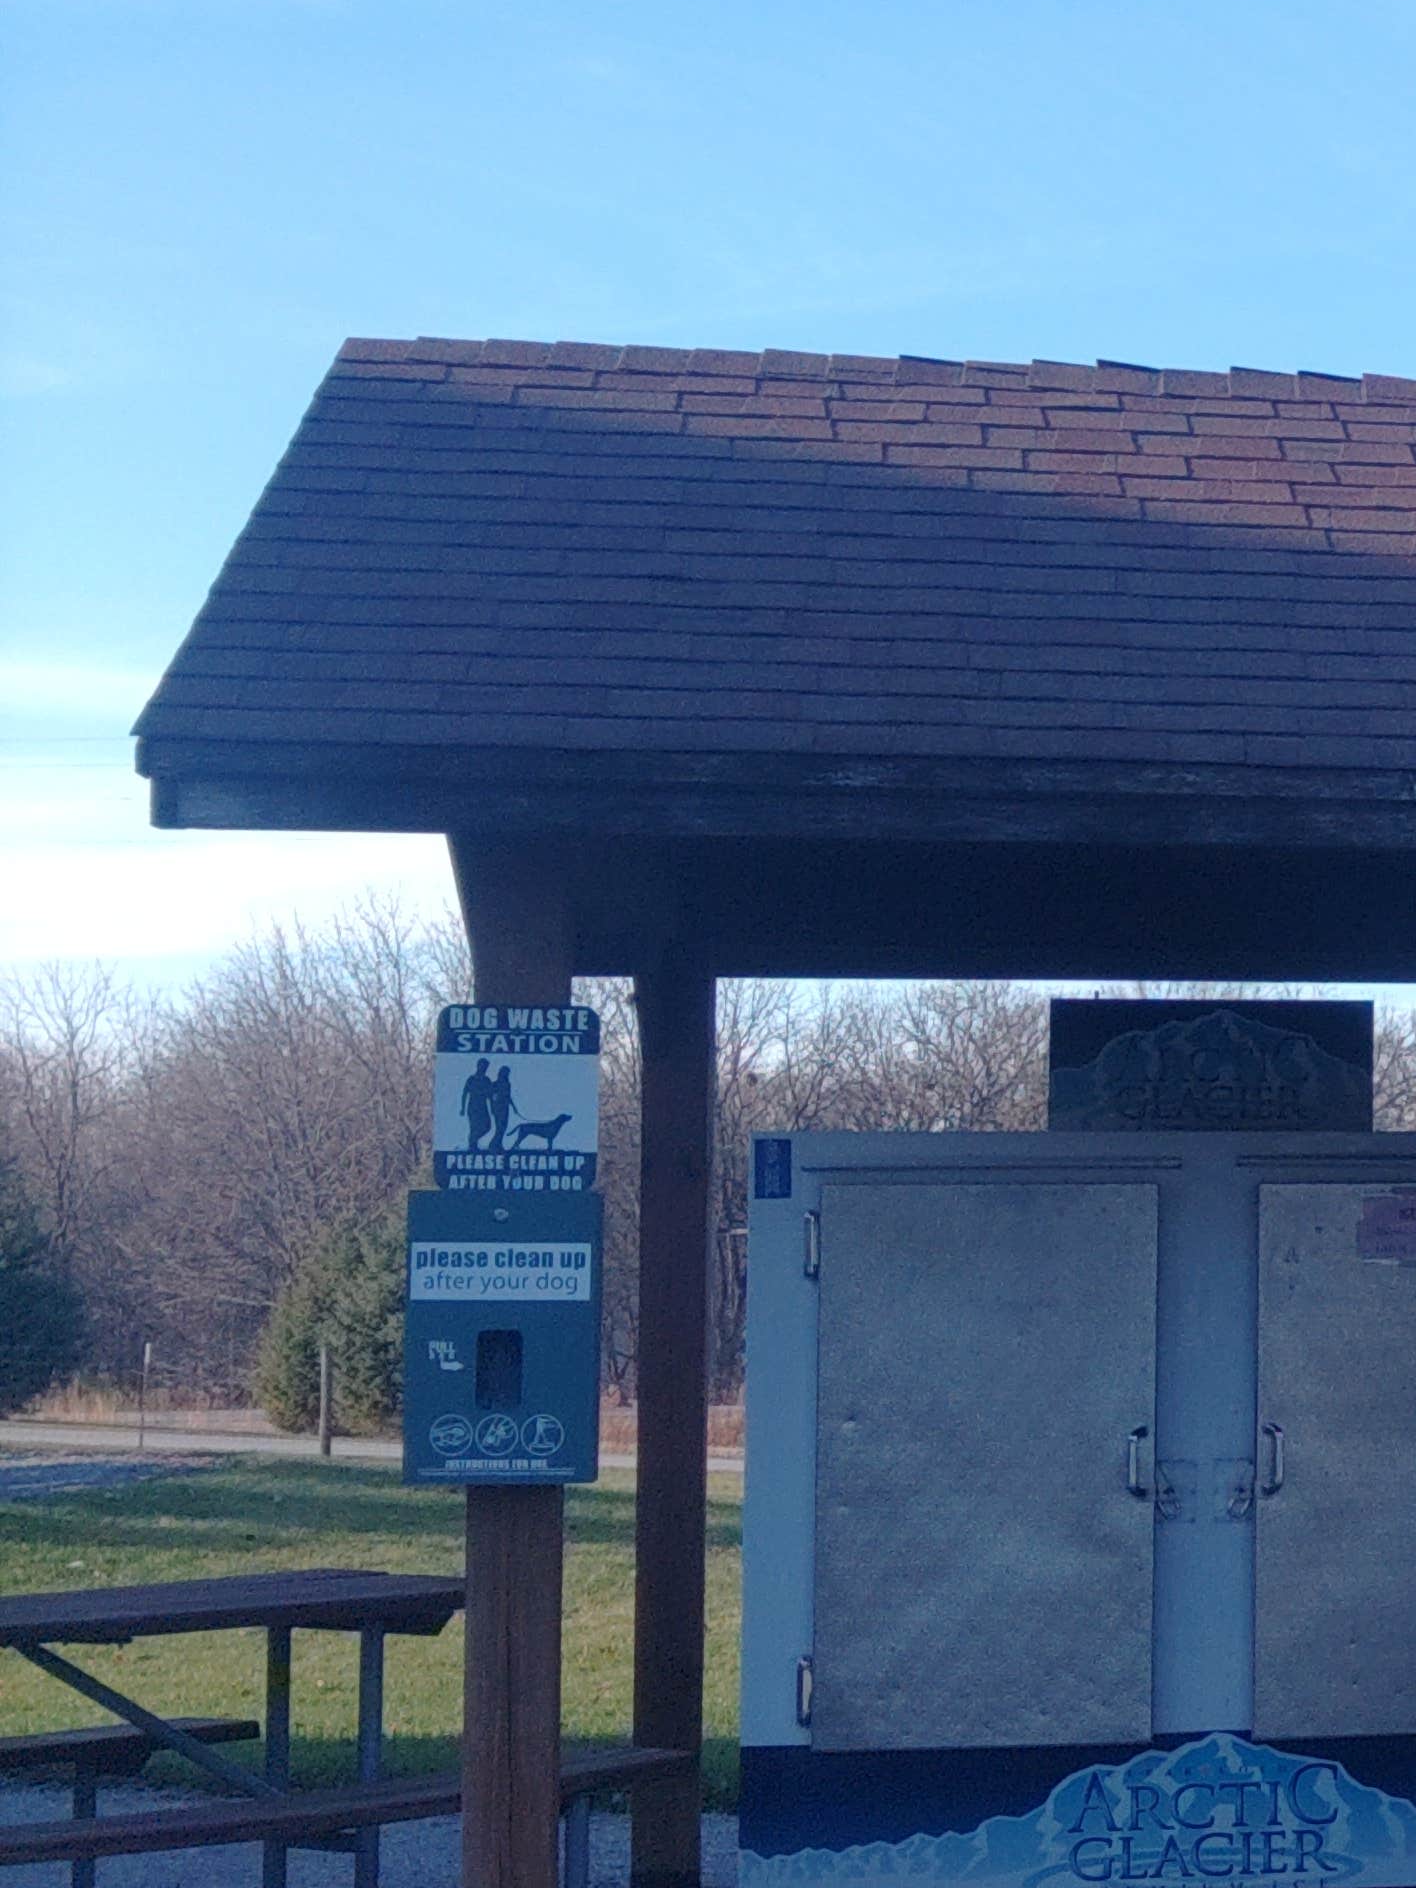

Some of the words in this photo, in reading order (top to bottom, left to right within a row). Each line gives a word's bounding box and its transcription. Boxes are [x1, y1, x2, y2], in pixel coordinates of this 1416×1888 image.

[450, 1007, 498, 1029] DOG
[507, 1008, 588, 1030] WASTE
[457, 1033, 580, 1053] STATION
[446, 1154, 505, 1170] PLEASE
[509, 1154, 559, 1170] CLEAN
[564, 1156, 585, 1171] UP
[416, 1247, 489, 1270] please
[494, 1247, 554, 1269] clean
[560, 1251, 586, 1271] up
[423, 1270, 474, 1290] after
[480, 1274, 529, 1295] your
[535, 1271, 579, 1295] dog
[1067, 1762, 1339, 1835] ARCTIC
[1067, 1828, 1339, 1883] GLACIER
